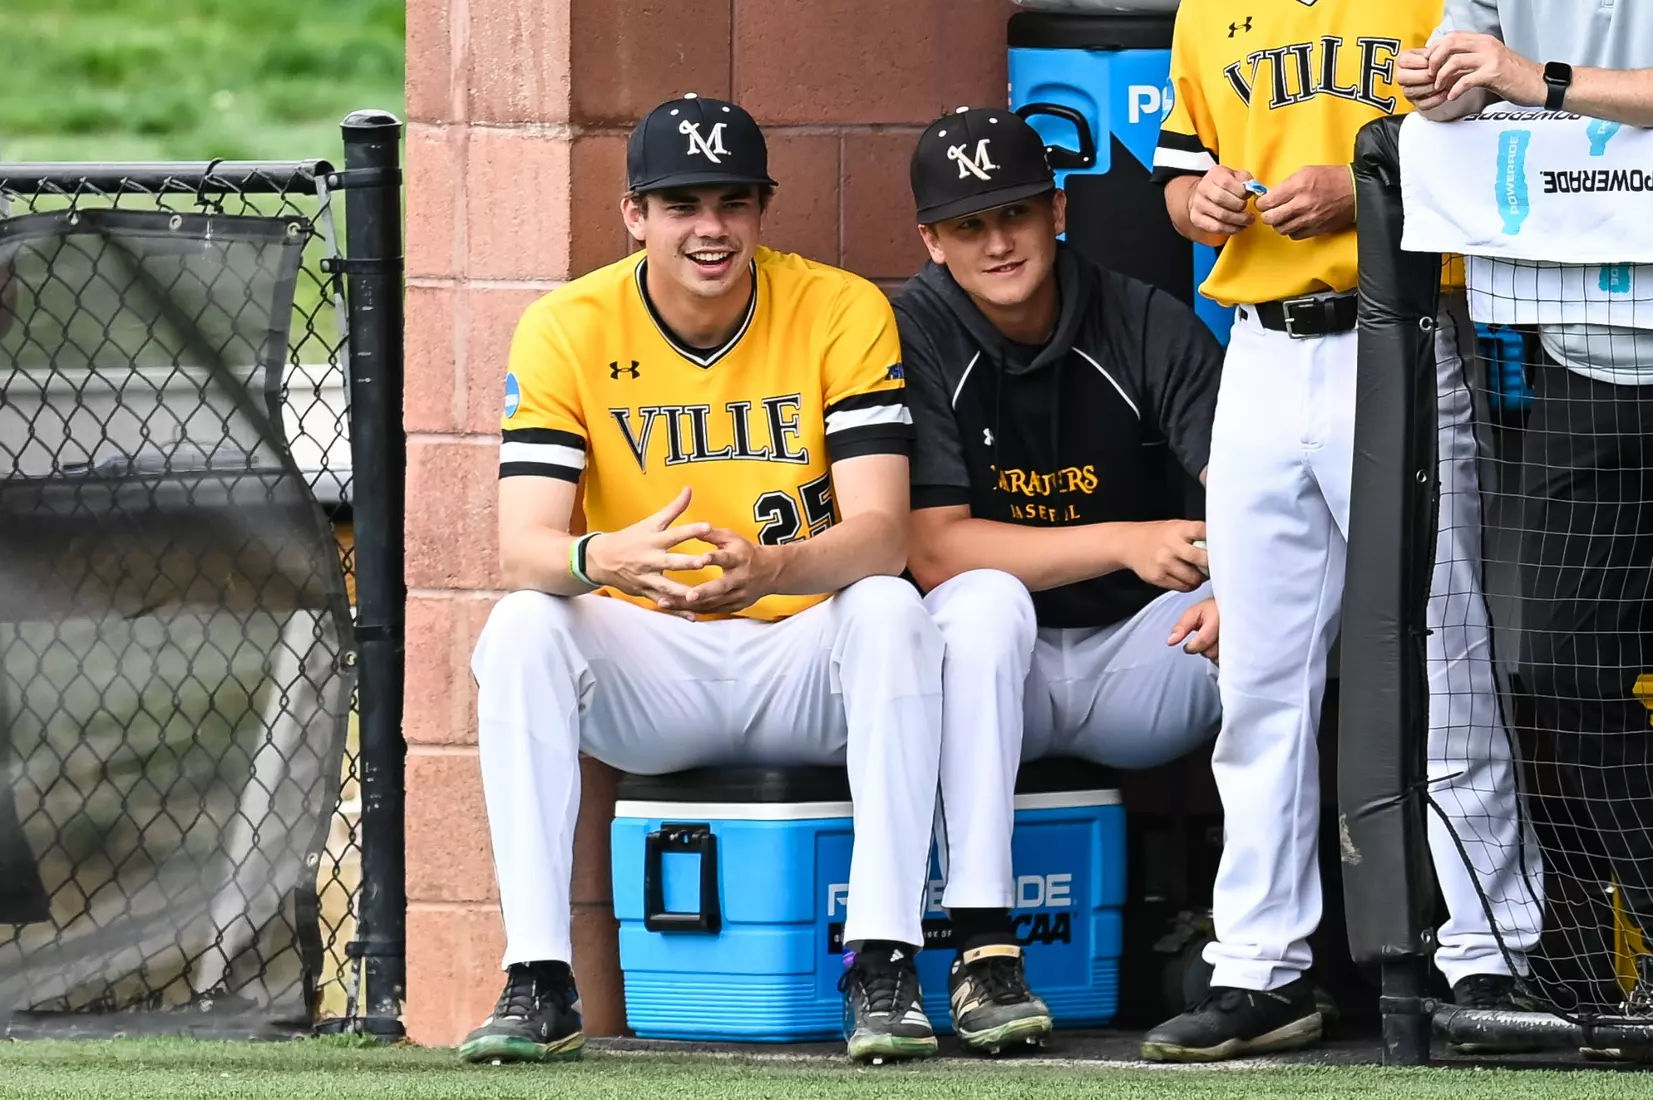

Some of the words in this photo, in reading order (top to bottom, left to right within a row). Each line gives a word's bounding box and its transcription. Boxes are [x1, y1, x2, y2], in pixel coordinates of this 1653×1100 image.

[1506, 136, 1519, 216] POWERADE
[609, 392, 810, 474] VILLE
[753, 472, 835, 546] 25
[1009, 912, 1071, 946] CAA
